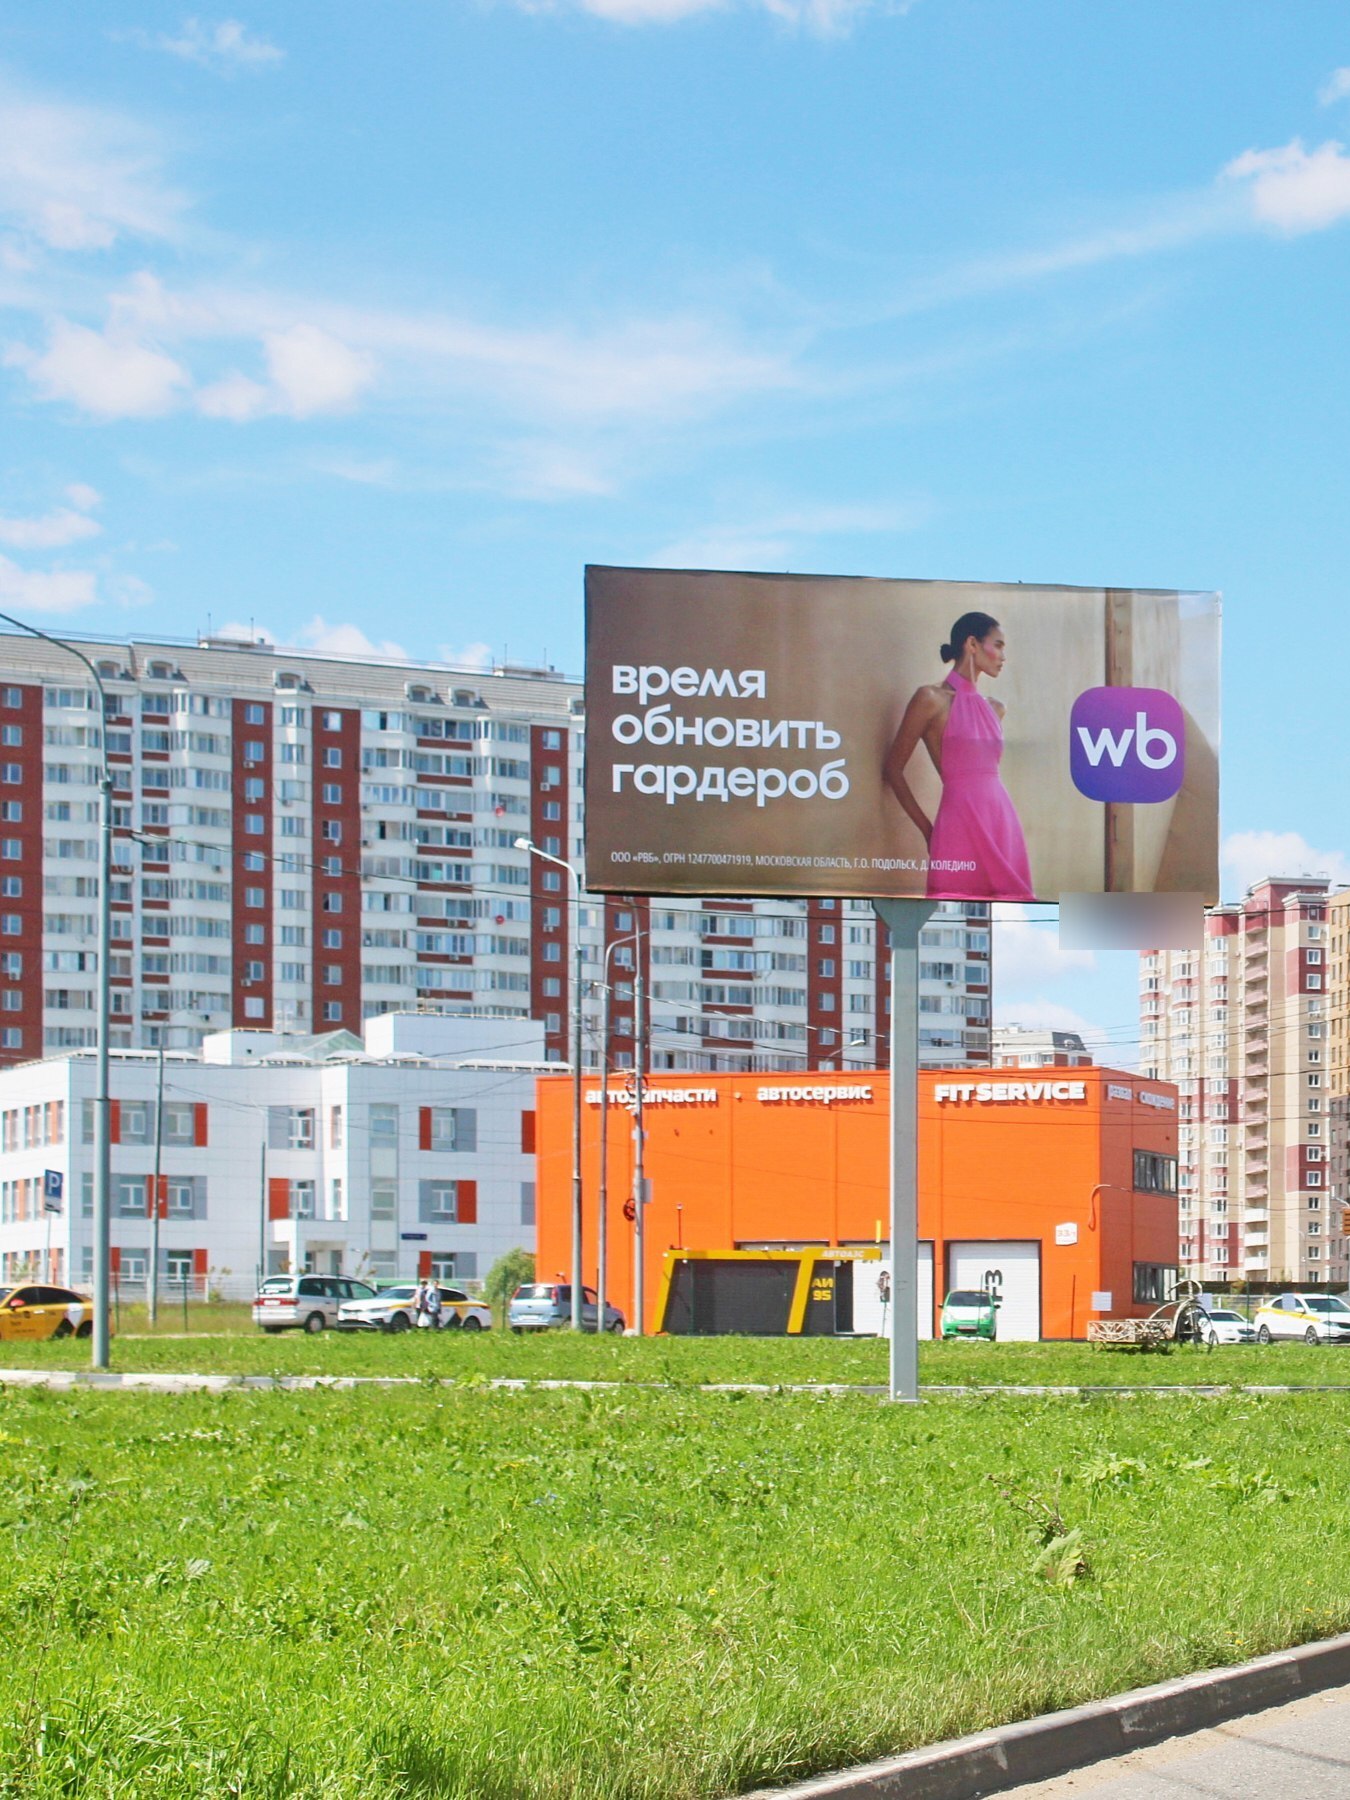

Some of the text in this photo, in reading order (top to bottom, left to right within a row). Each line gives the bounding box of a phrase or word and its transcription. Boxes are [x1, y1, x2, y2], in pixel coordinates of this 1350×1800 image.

[612, 665, 766, 705] время
[611, 703, 842, 750] обновить
[1077, 711, 1177, 770] wb
[612, 758, 850, 808] гардероб
[611, 852, 631, 863] ООО
[663, 852, 686, 864] ОГРН
[756, 855, 812, 868] МОСКОВСКАЯ
[814, 856, 852, 869] ОБЛАСТЬ,
[930, 859, 977, 872] КОЛЕДИНО
[757, 1085, 873, 1104] автосервис
